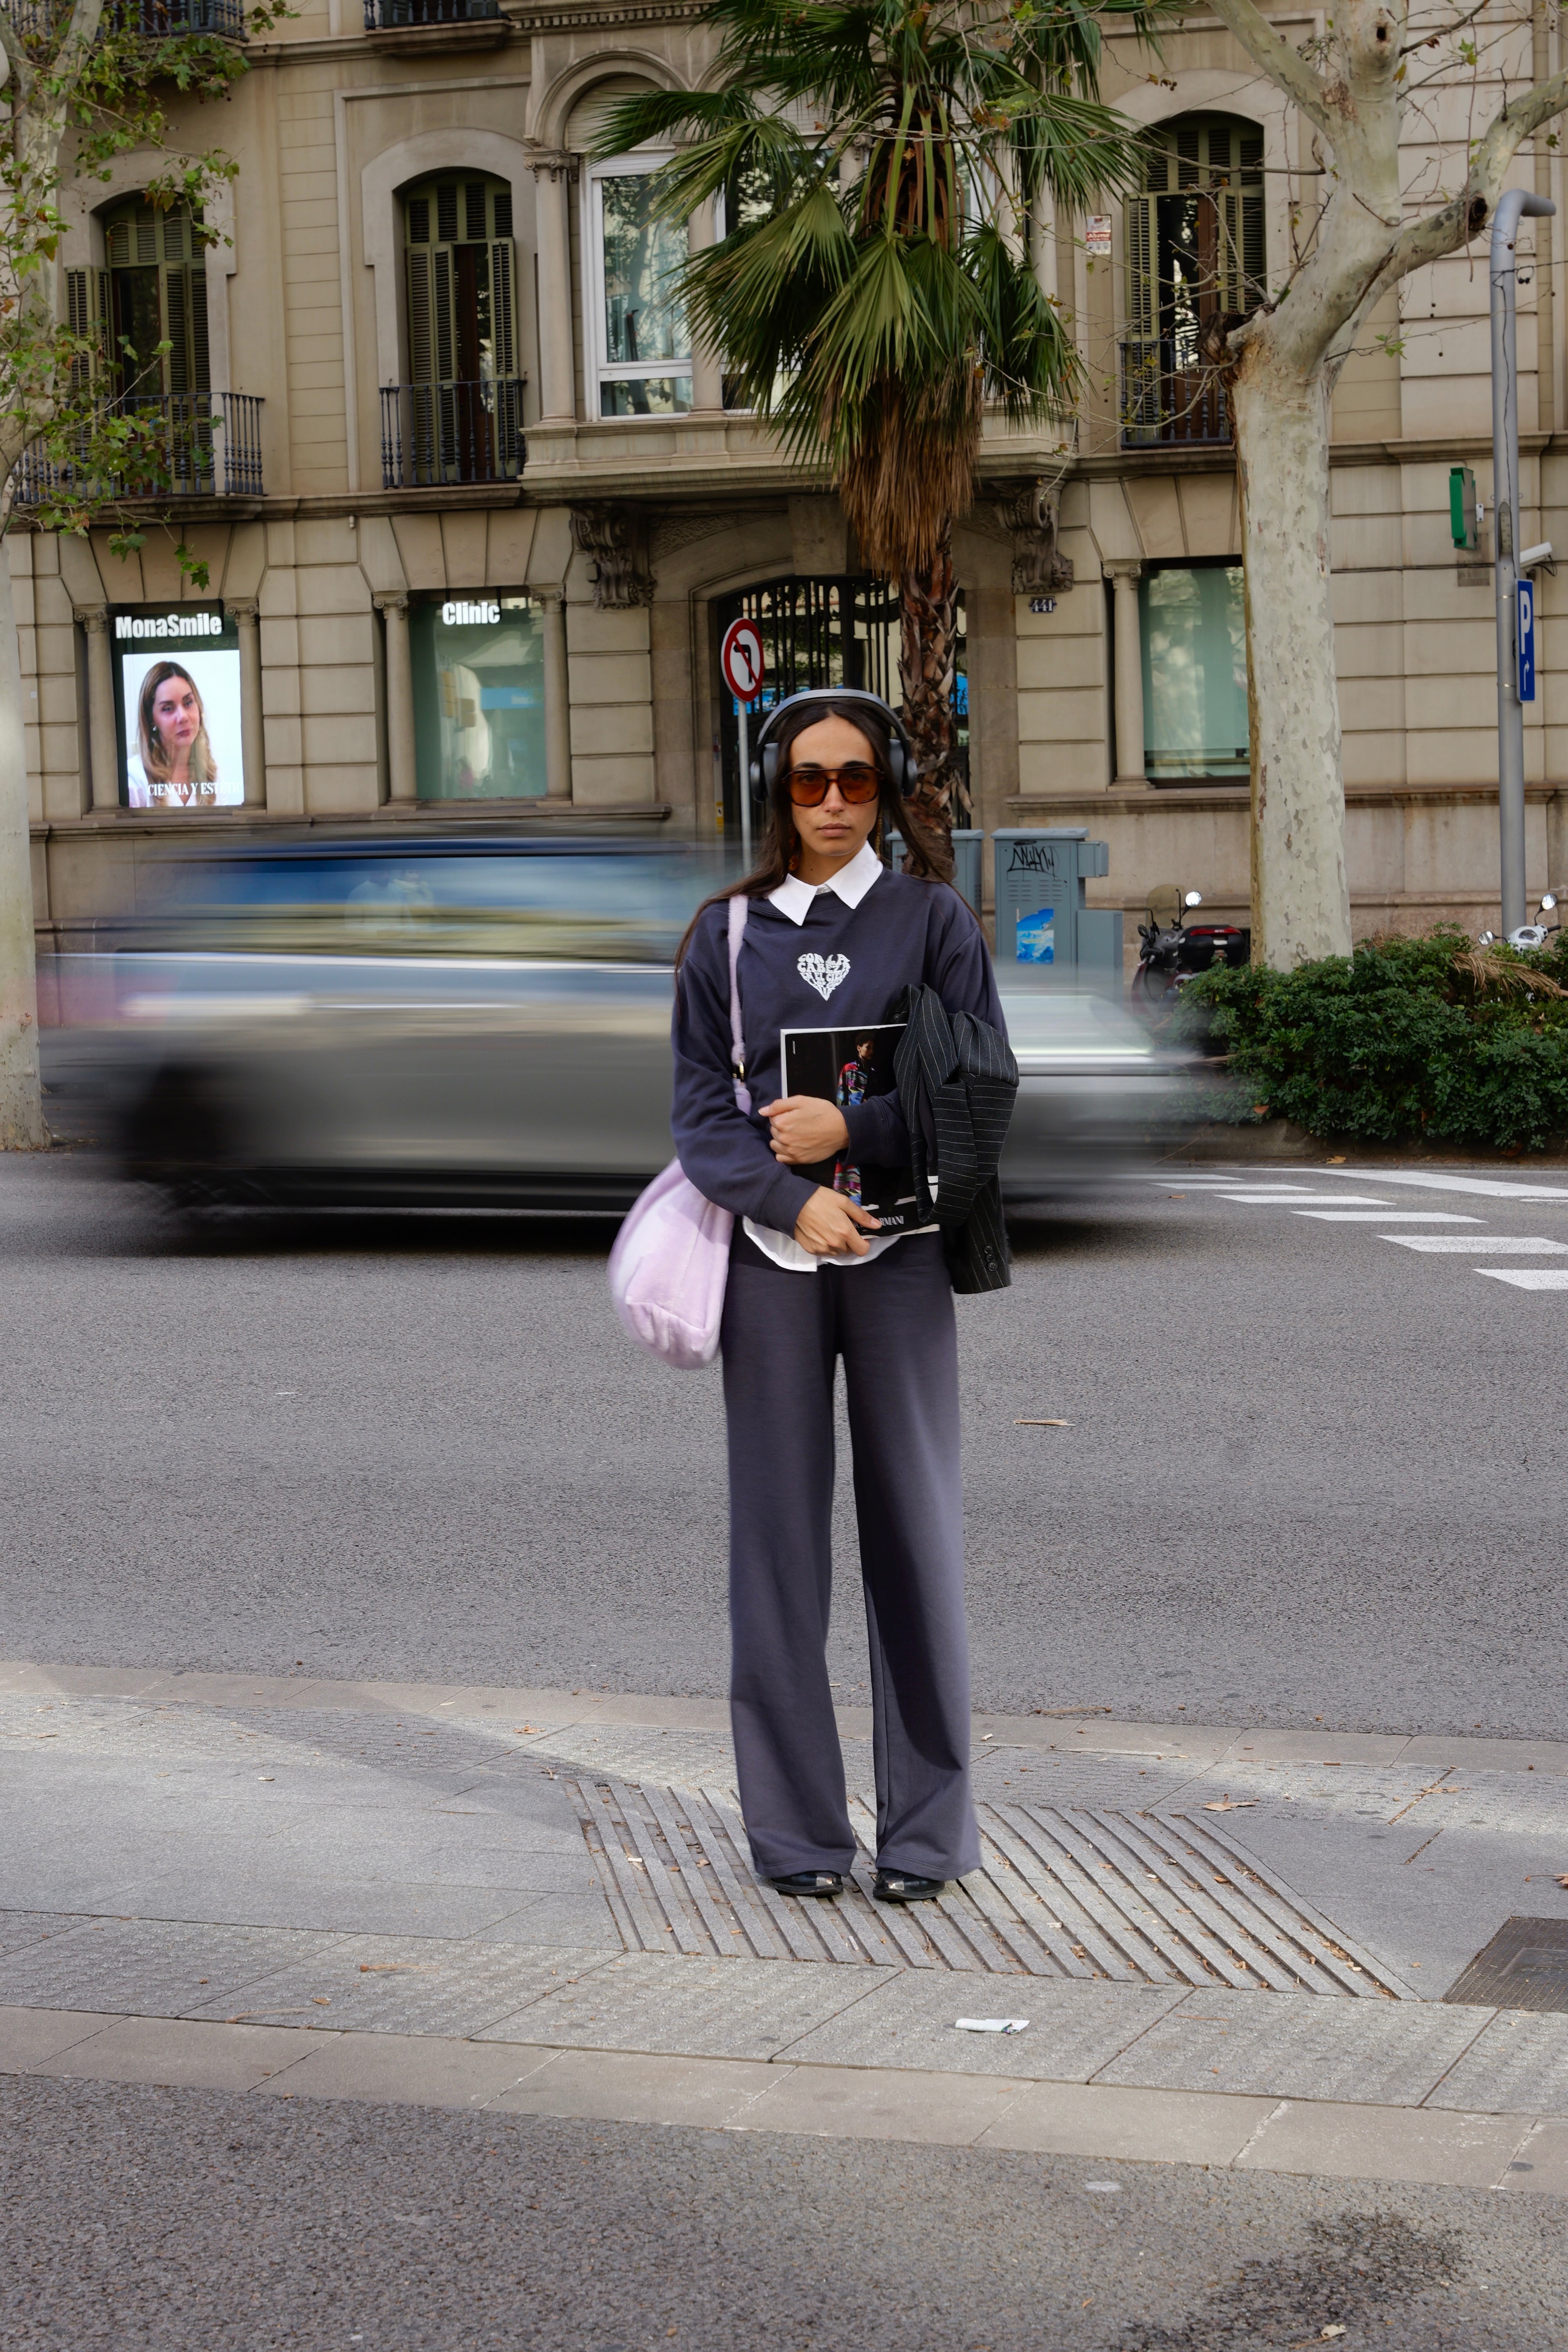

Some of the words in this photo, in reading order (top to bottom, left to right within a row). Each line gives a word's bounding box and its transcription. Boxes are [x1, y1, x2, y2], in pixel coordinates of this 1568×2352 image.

[1032, 599, 1053, 612] 441
[442, 601, 501, 625] Clinic
[116, 613, 222, 639] MonaSmile
[1520, 590, 1531, 654] P
[147, 783, 189, 796] CIENCIA
[190, 783, 198, 795] Y
[797, 953, 825, 964] CON
[825, 953, 851, 966] LA
[797, 962, 851, 974] CABEZA
[814, 972, 825, 982] EL
[878, 1215, 904, 1226] RMANI
